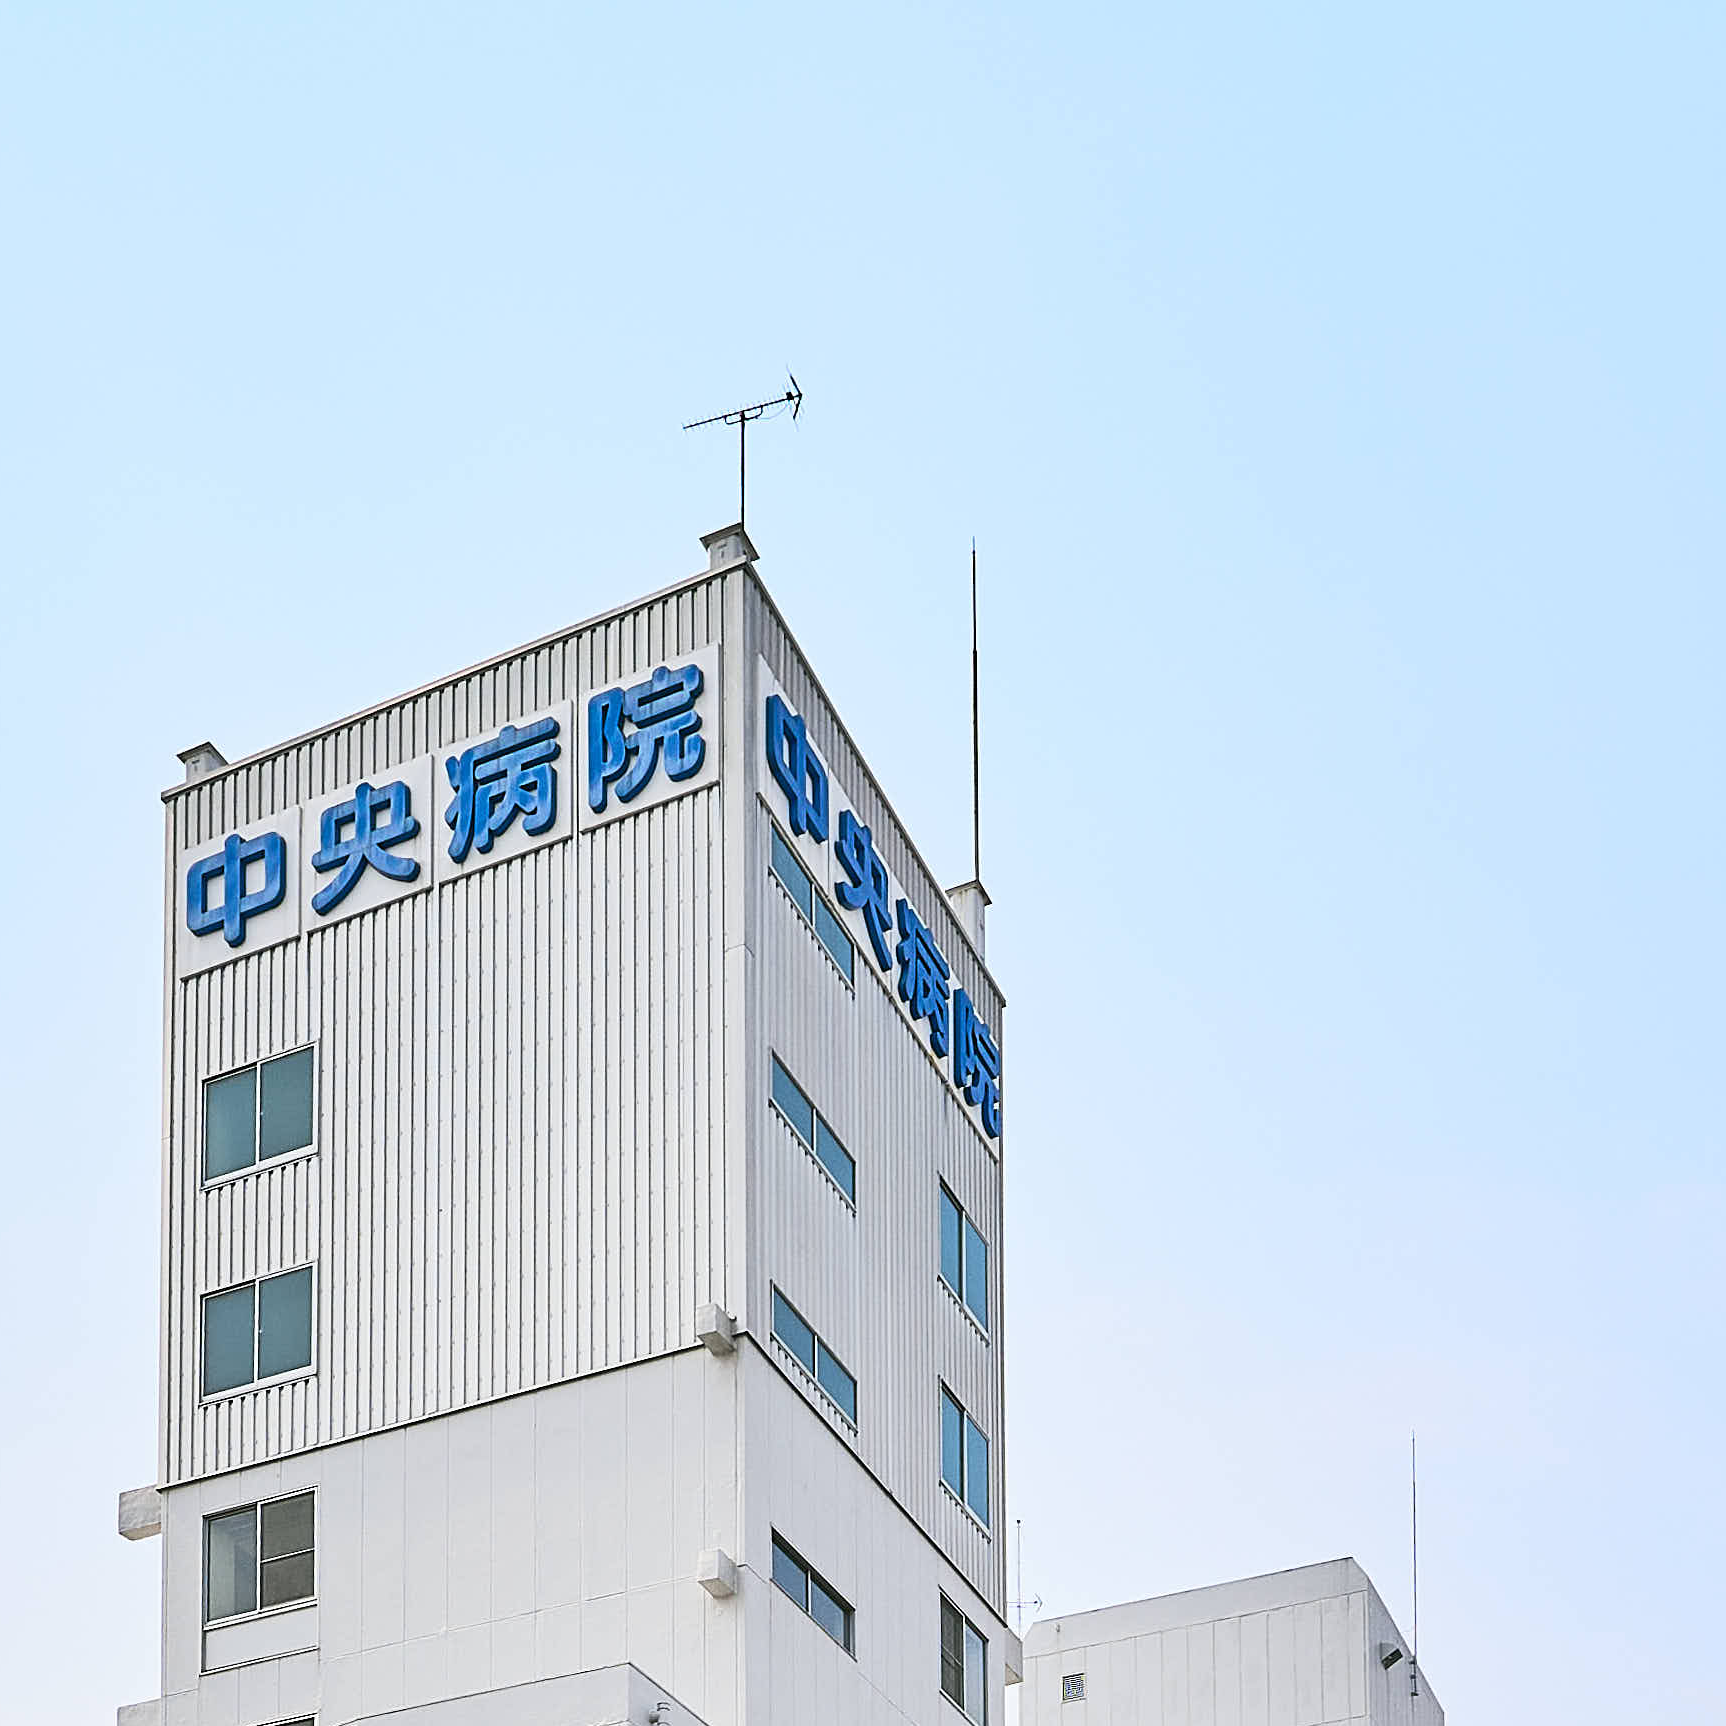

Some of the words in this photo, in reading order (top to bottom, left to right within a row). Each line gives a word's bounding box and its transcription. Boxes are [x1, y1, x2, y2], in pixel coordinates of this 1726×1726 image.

[186, 664, 704, 948] 中央病院
[766, 694, 1001, 1138] 中央病院
